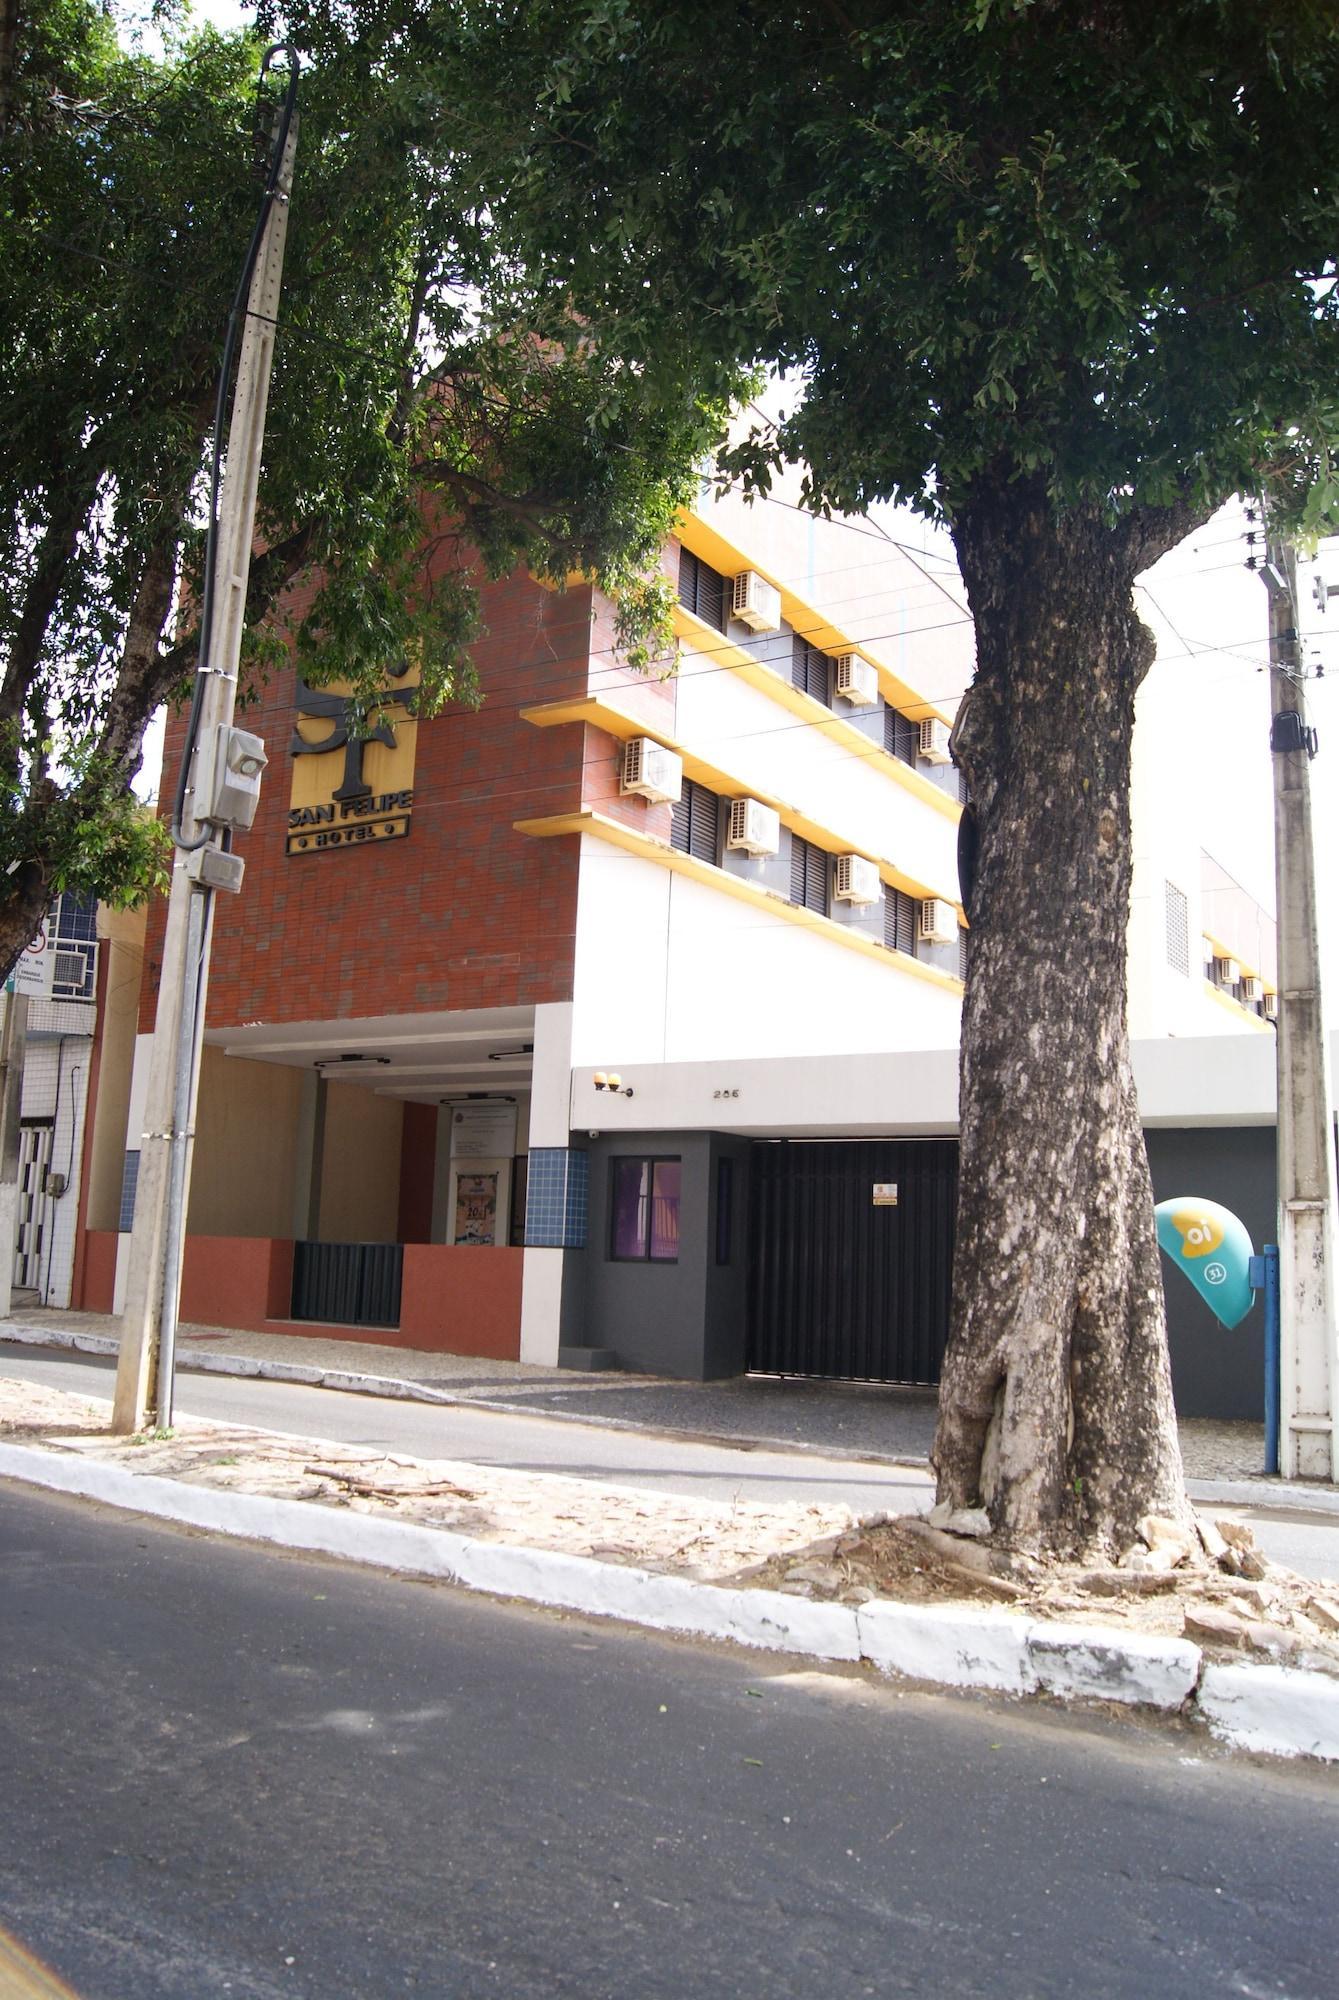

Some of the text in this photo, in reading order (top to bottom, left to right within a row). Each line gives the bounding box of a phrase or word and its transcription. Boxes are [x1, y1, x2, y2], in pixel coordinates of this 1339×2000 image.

[288, 789, 413, 828] SAN FELIPE
[316, 826, 377, 847] HOTEL
[1208, 1266, 1223, 1281] 31
